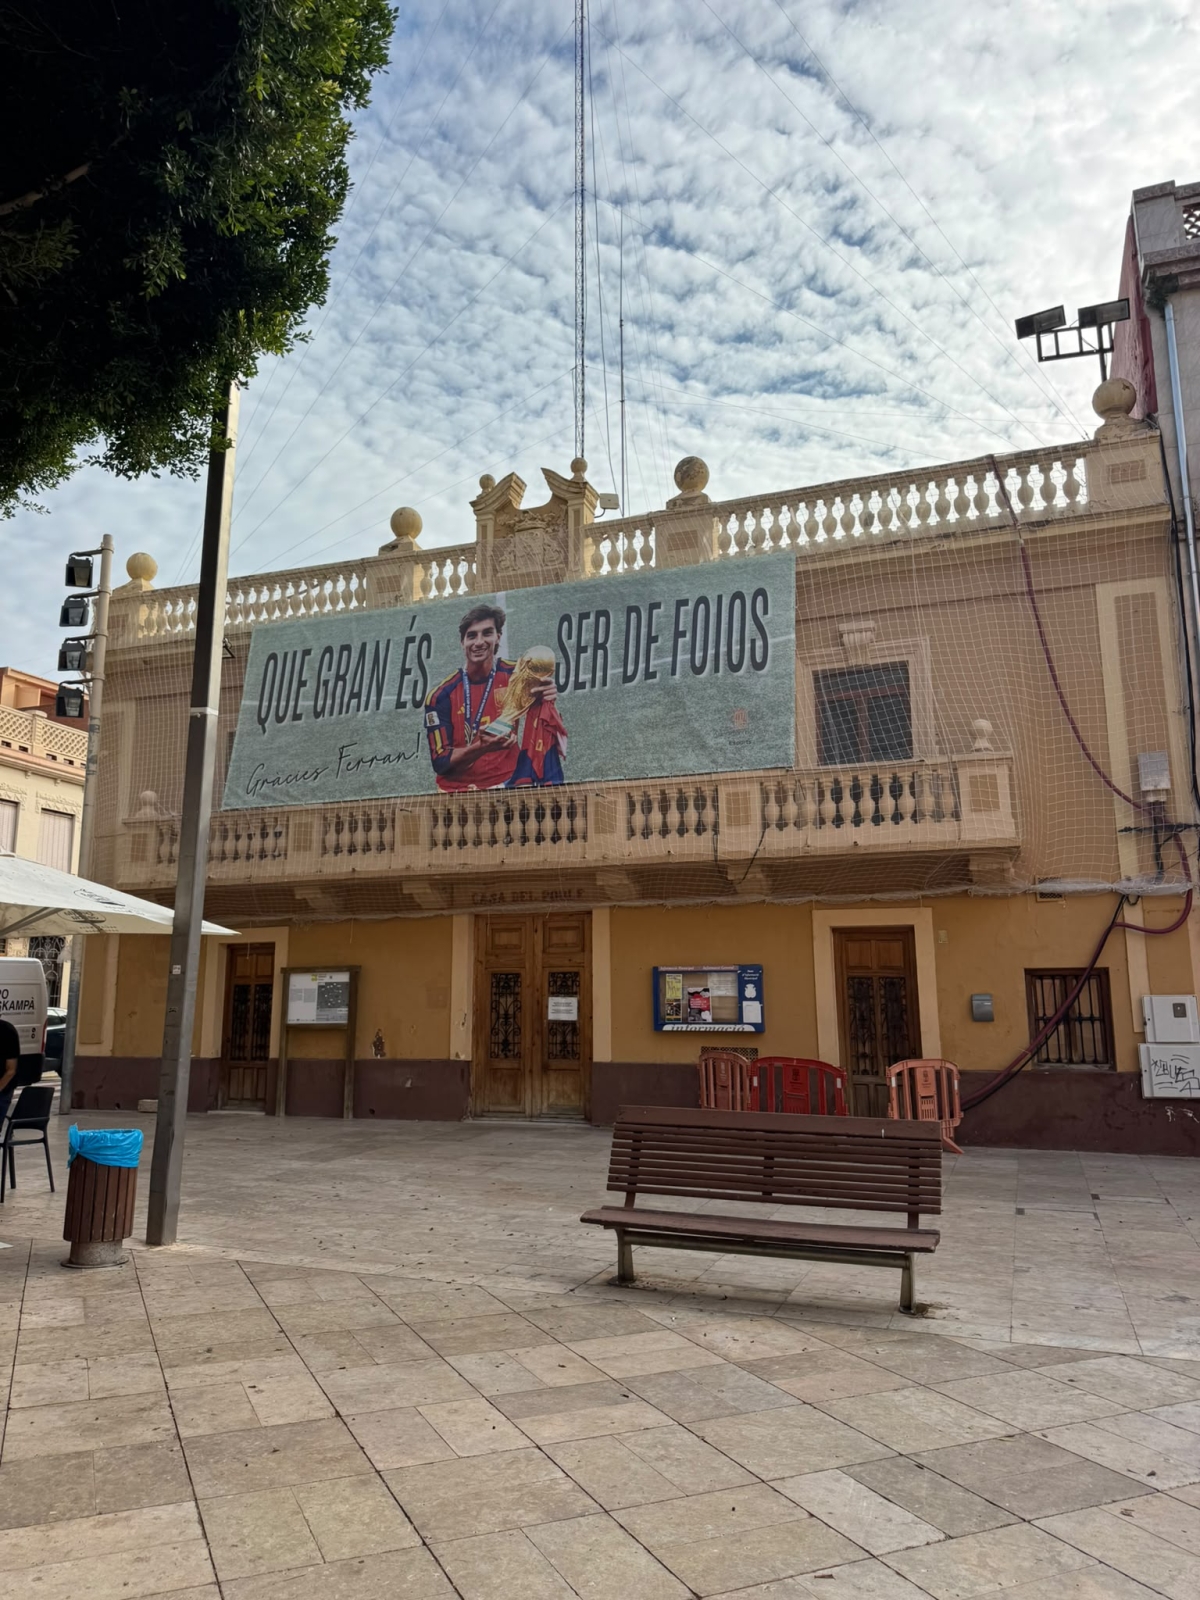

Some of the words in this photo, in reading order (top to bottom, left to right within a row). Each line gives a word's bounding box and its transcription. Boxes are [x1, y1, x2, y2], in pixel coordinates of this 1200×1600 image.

[257, 648, 312, 734] QUE
[313, 639, 391, 719] GRAN
[395, 615, 432, 709] ÉS
[555, 609, 611, 693] SER
[622, 602, 662, 684] DE
[670, 587, 769, 676] FOIOS
[246, 763, 329, 797] Gràcies
[335, 732, 421, 779] Ferran!
